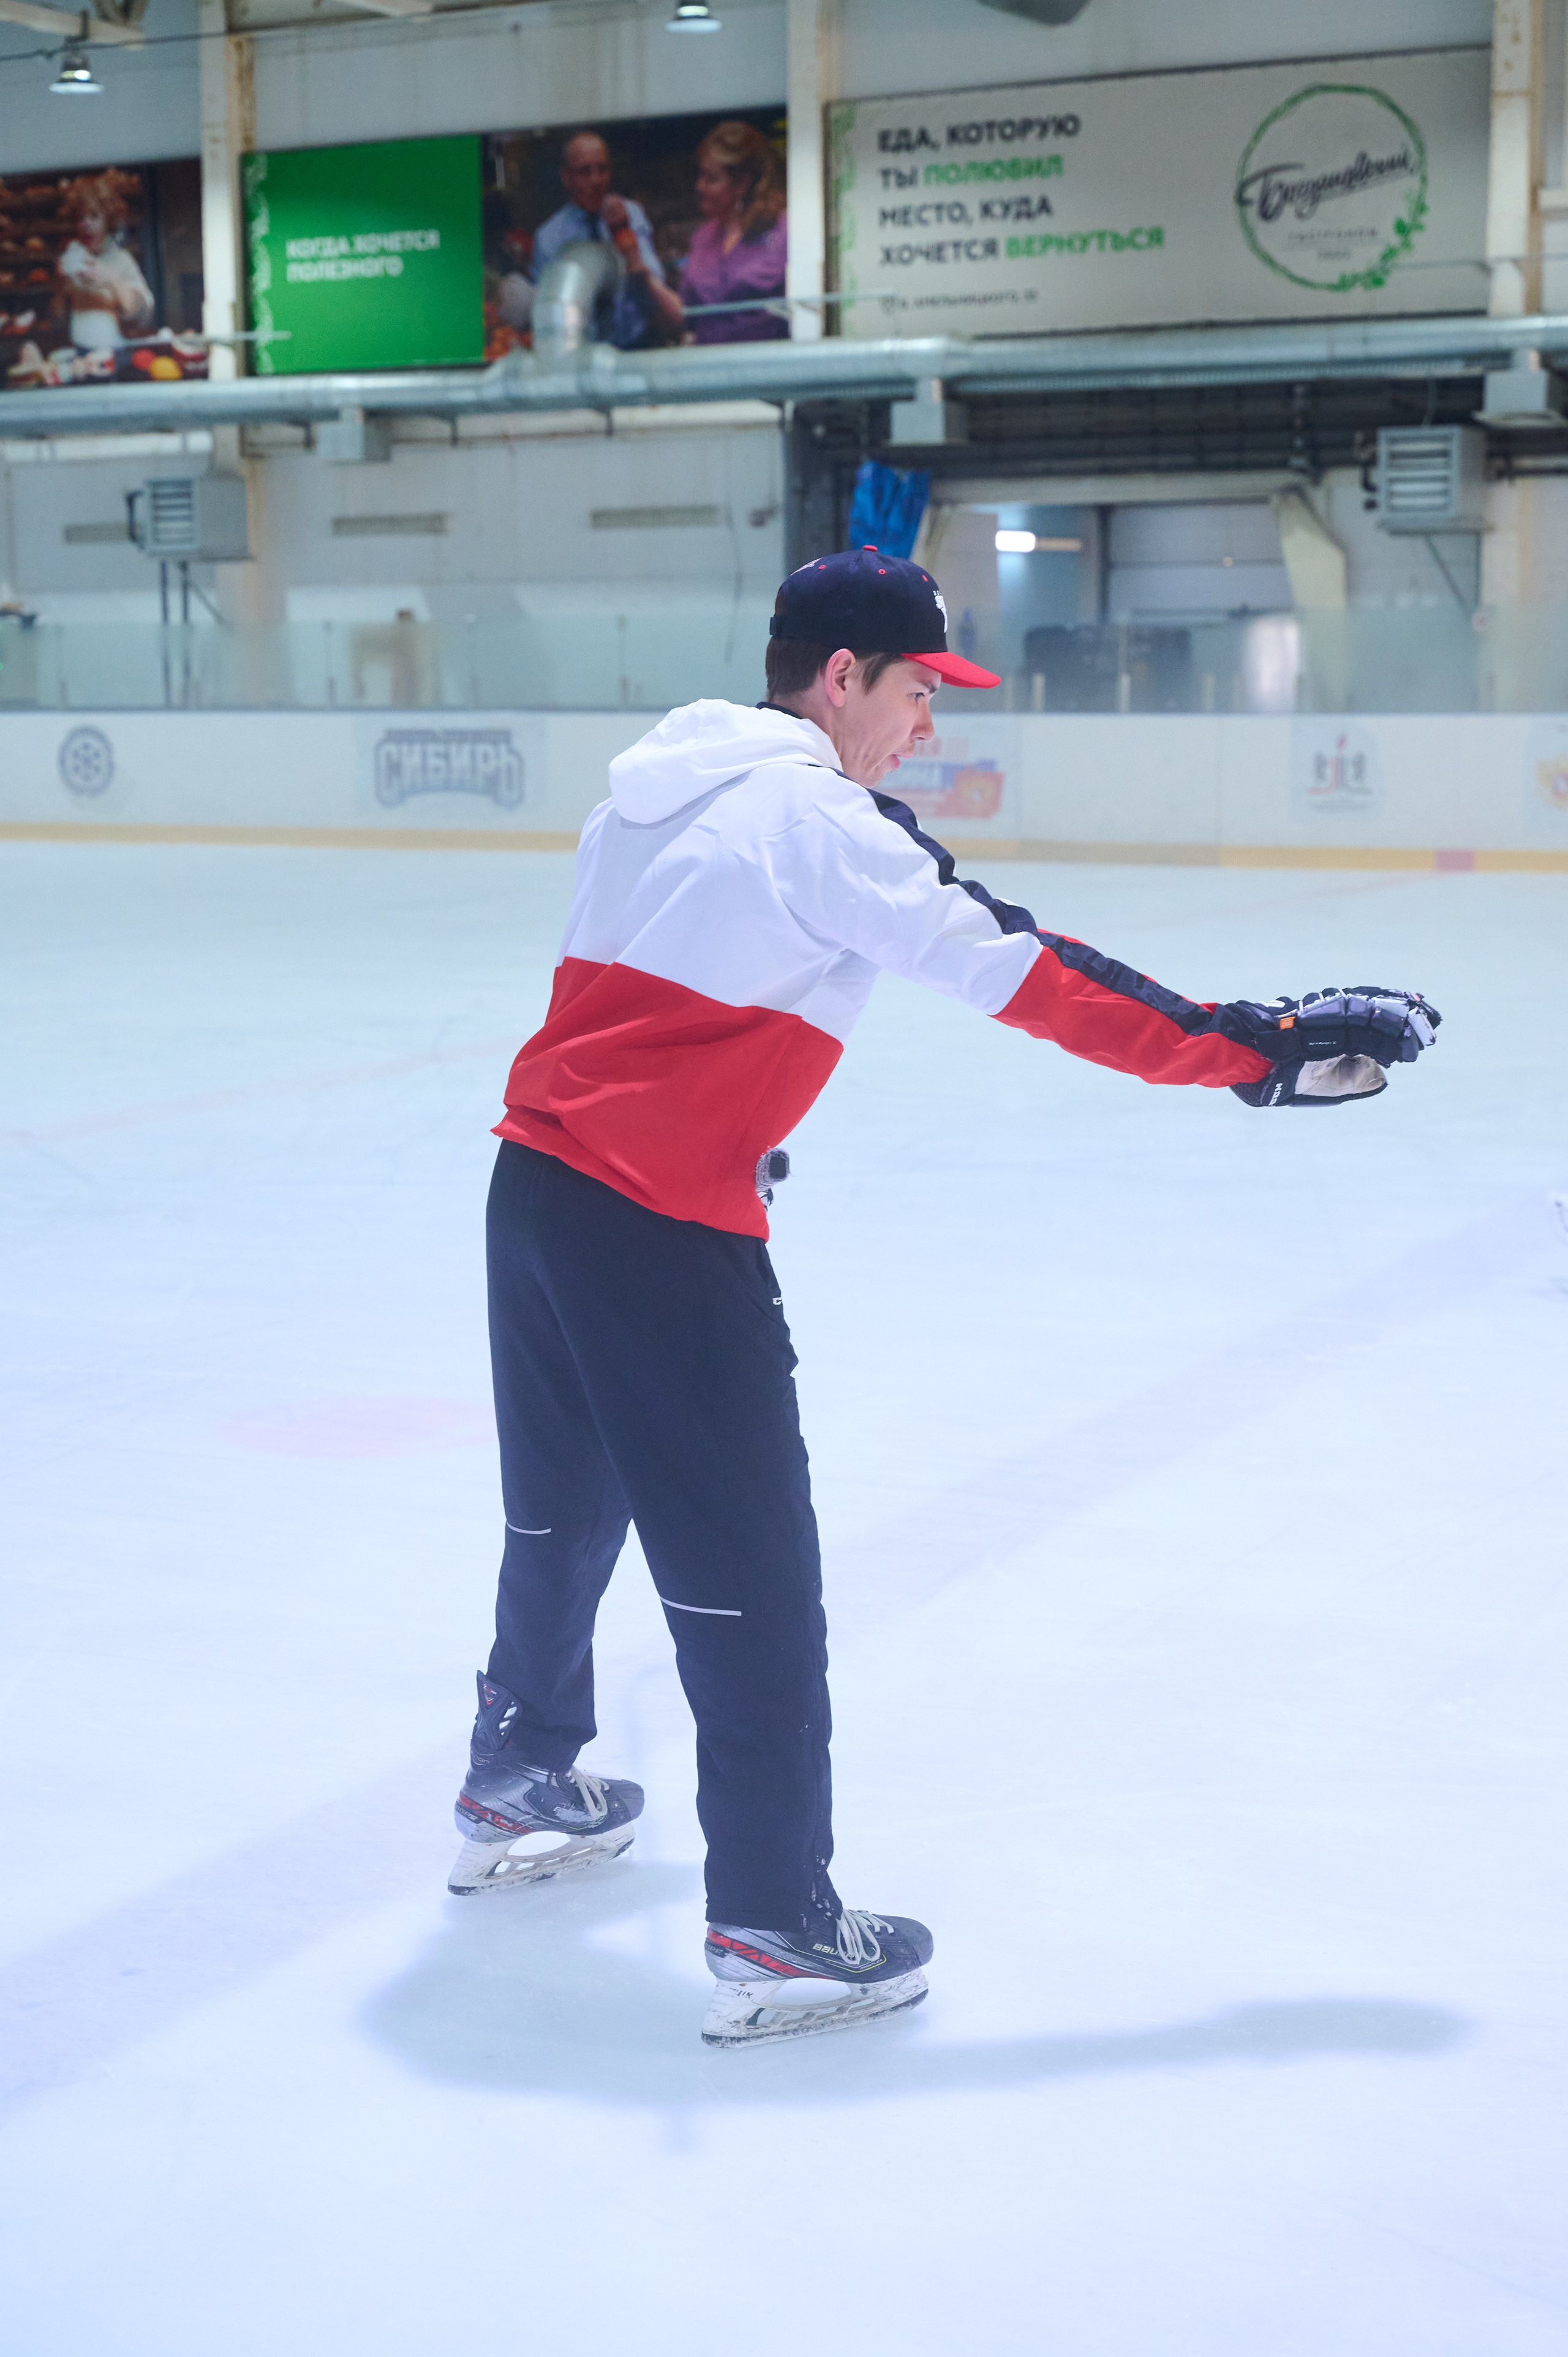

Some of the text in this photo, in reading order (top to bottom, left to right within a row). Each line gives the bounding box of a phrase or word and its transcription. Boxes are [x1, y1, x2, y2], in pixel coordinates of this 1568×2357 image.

[877, 114, 1081, 153] ЕДА, КОТОРУЮ
[879, 154, 1064, 190] ТЫ ПОЛЮБИЛ
[879, 195, 1054, 227] МЕСТО, КУДА
[287, 230, 439, 257] КОГДА ХОЧЕТСЯ
[879, 226, 1164, 267] ХОЧЕТСЯ ВЕРНУТЬСЯ
[287, 256, 402, 281] ПОЛЕЗНОГО
[376, 736, 523, 807] СИБИРЬ
